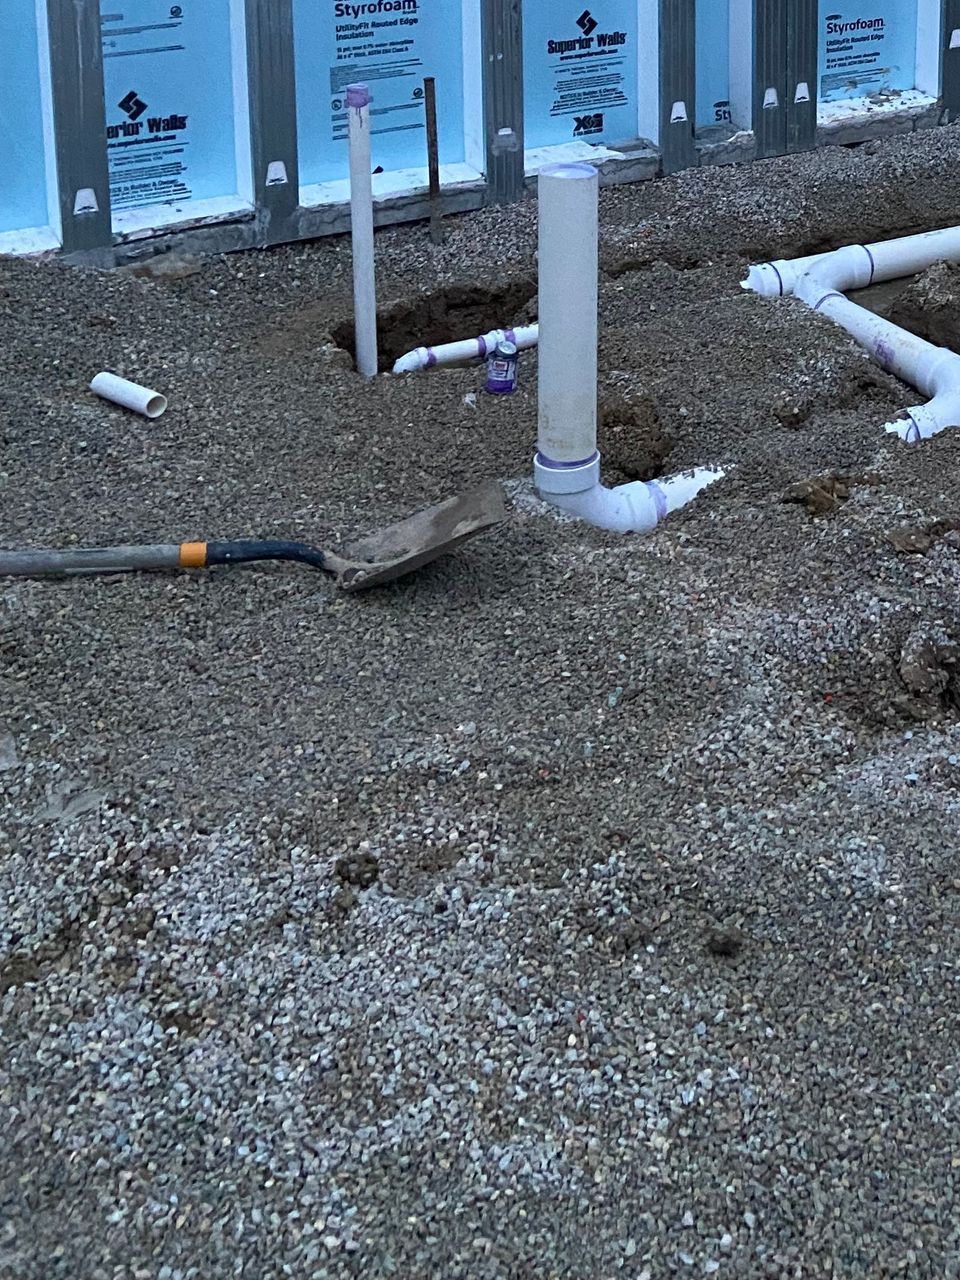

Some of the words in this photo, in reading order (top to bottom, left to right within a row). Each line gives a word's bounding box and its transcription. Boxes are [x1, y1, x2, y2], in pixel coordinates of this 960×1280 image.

[335, 23, 370, 33] UtilityFit
[371, 19, 398, 29] Routed
[400, 17, 418, 26] Edge
[827, 18, 884, 35] Styrofoam
[336, 30, 374, 41] Insulation
[548, 37, 594, 54] Superior
[597, 32, 626, 48] Walls
[107, 121, 143, 139] erior
[147, 114, 187, 133] Walls
